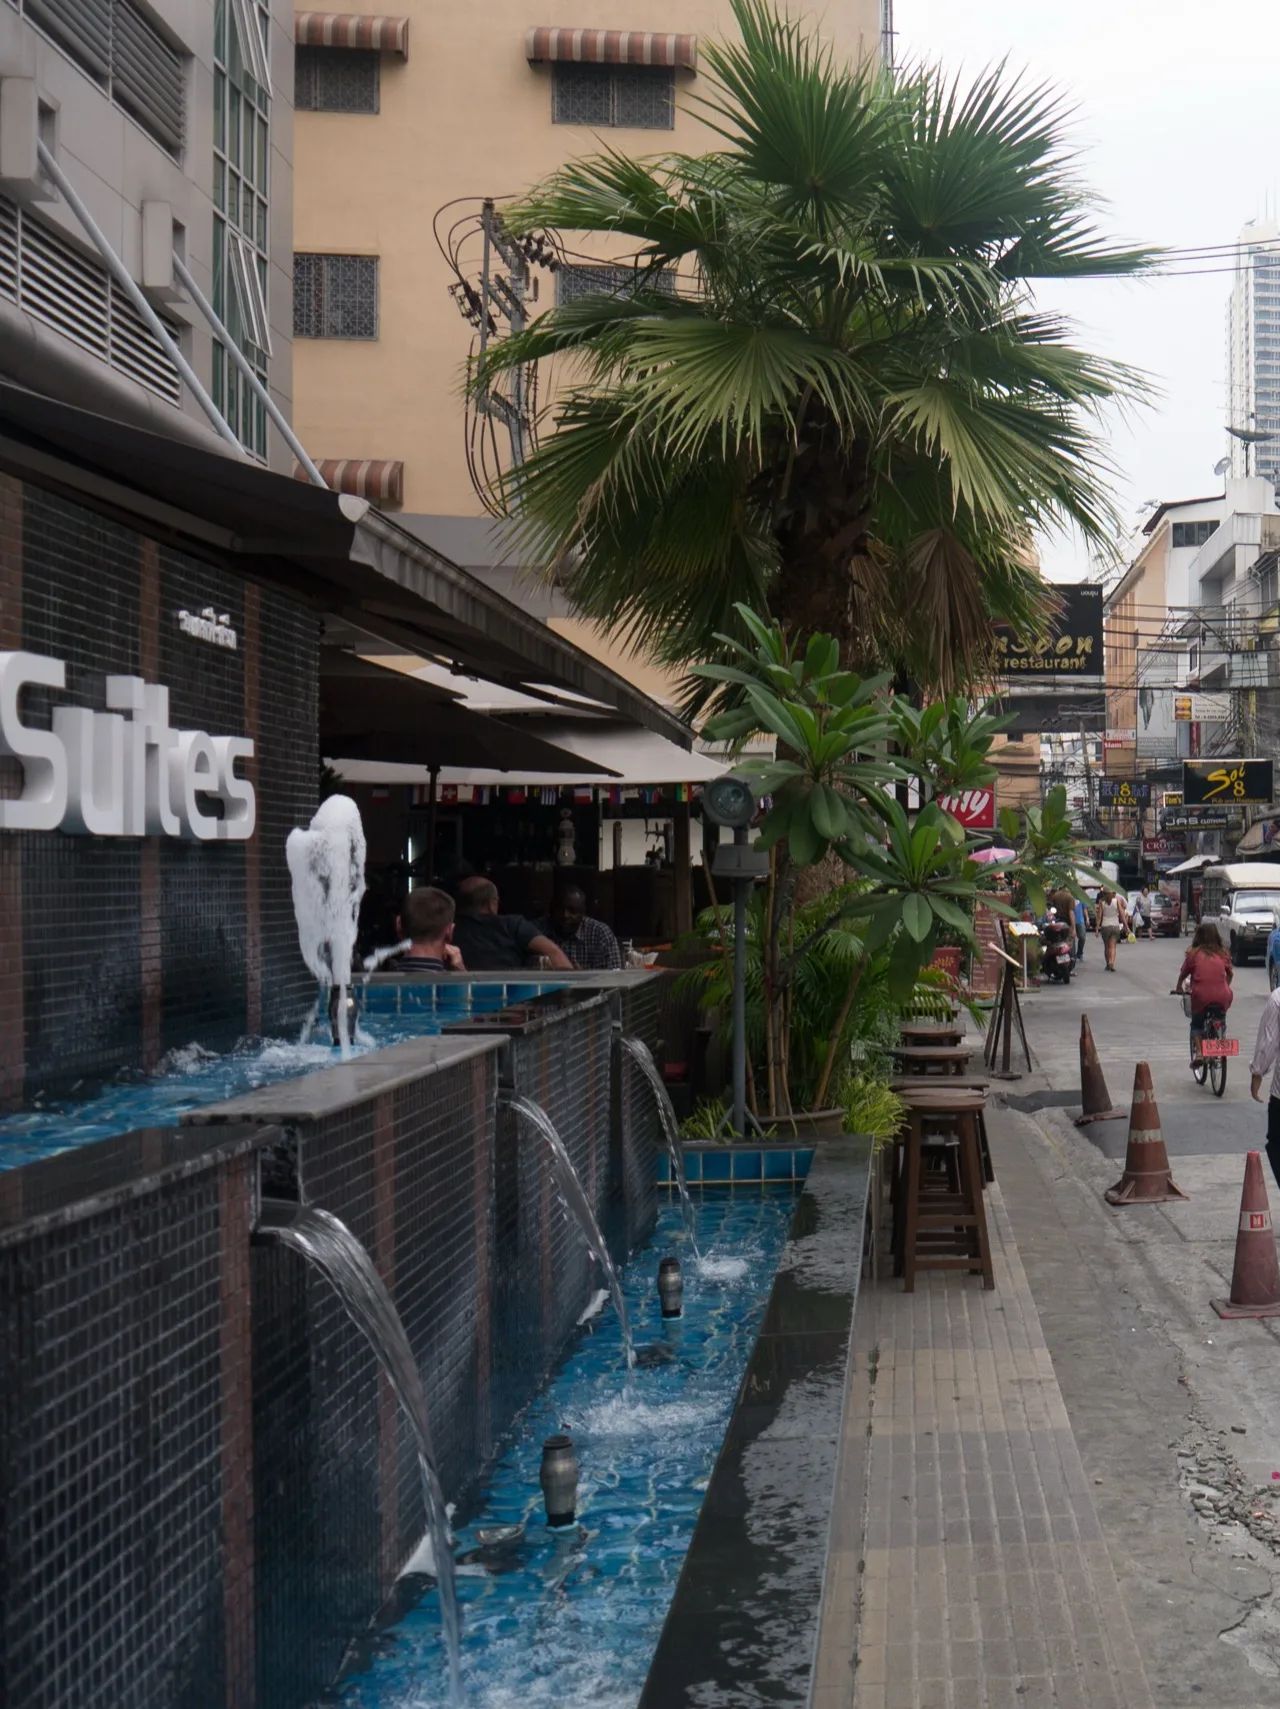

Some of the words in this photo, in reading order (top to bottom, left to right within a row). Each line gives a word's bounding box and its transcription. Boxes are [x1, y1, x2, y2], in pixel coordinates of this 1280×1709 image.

[1004, 656, 1087, 670] restaurant
[0, 651, 256, 840] Suites
[1202, 761, 1246, 800] Soi
[1233, 780, 1245, 797] 8
[1113, 797, 1138, 805] INN
[1165, 817, 1198, 826] JAS
